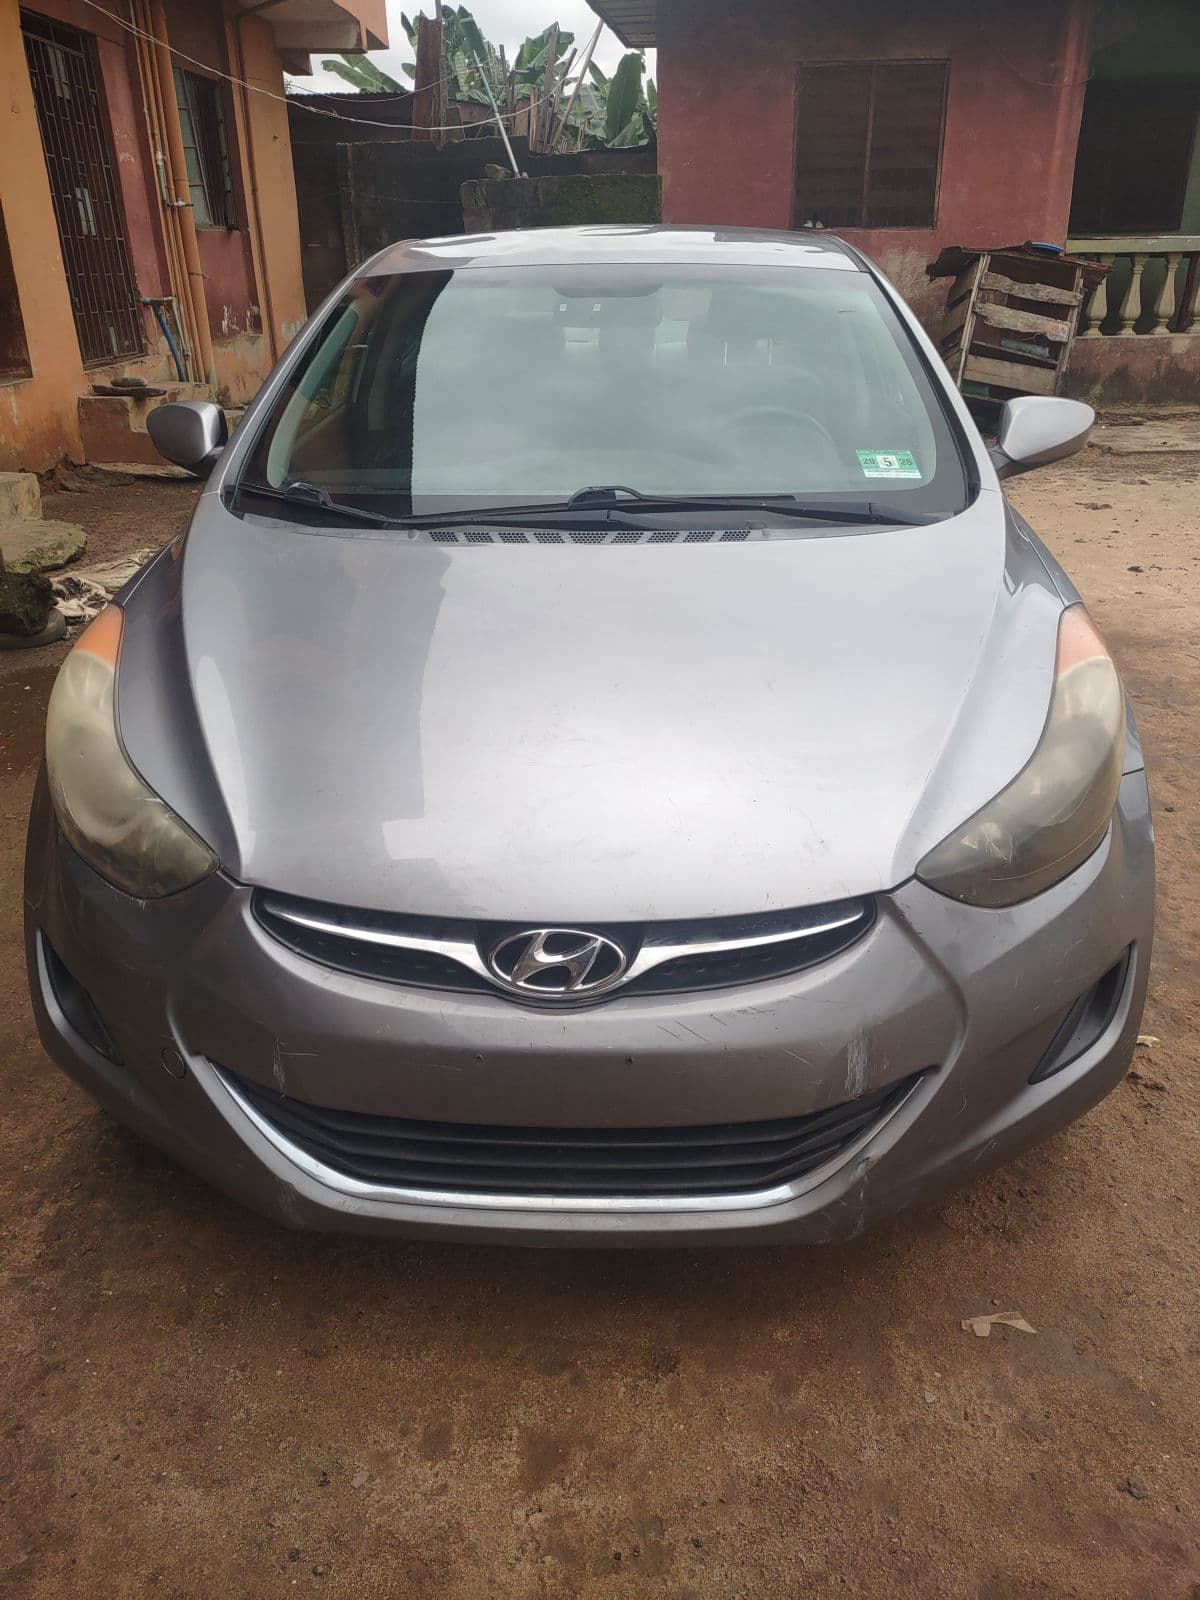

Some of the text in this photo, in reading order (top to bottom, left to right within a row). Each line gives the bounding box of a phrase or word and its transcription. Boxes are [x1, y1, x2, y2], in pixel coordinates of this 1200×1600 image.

[863, 457, 913, 467] 20 5 25
